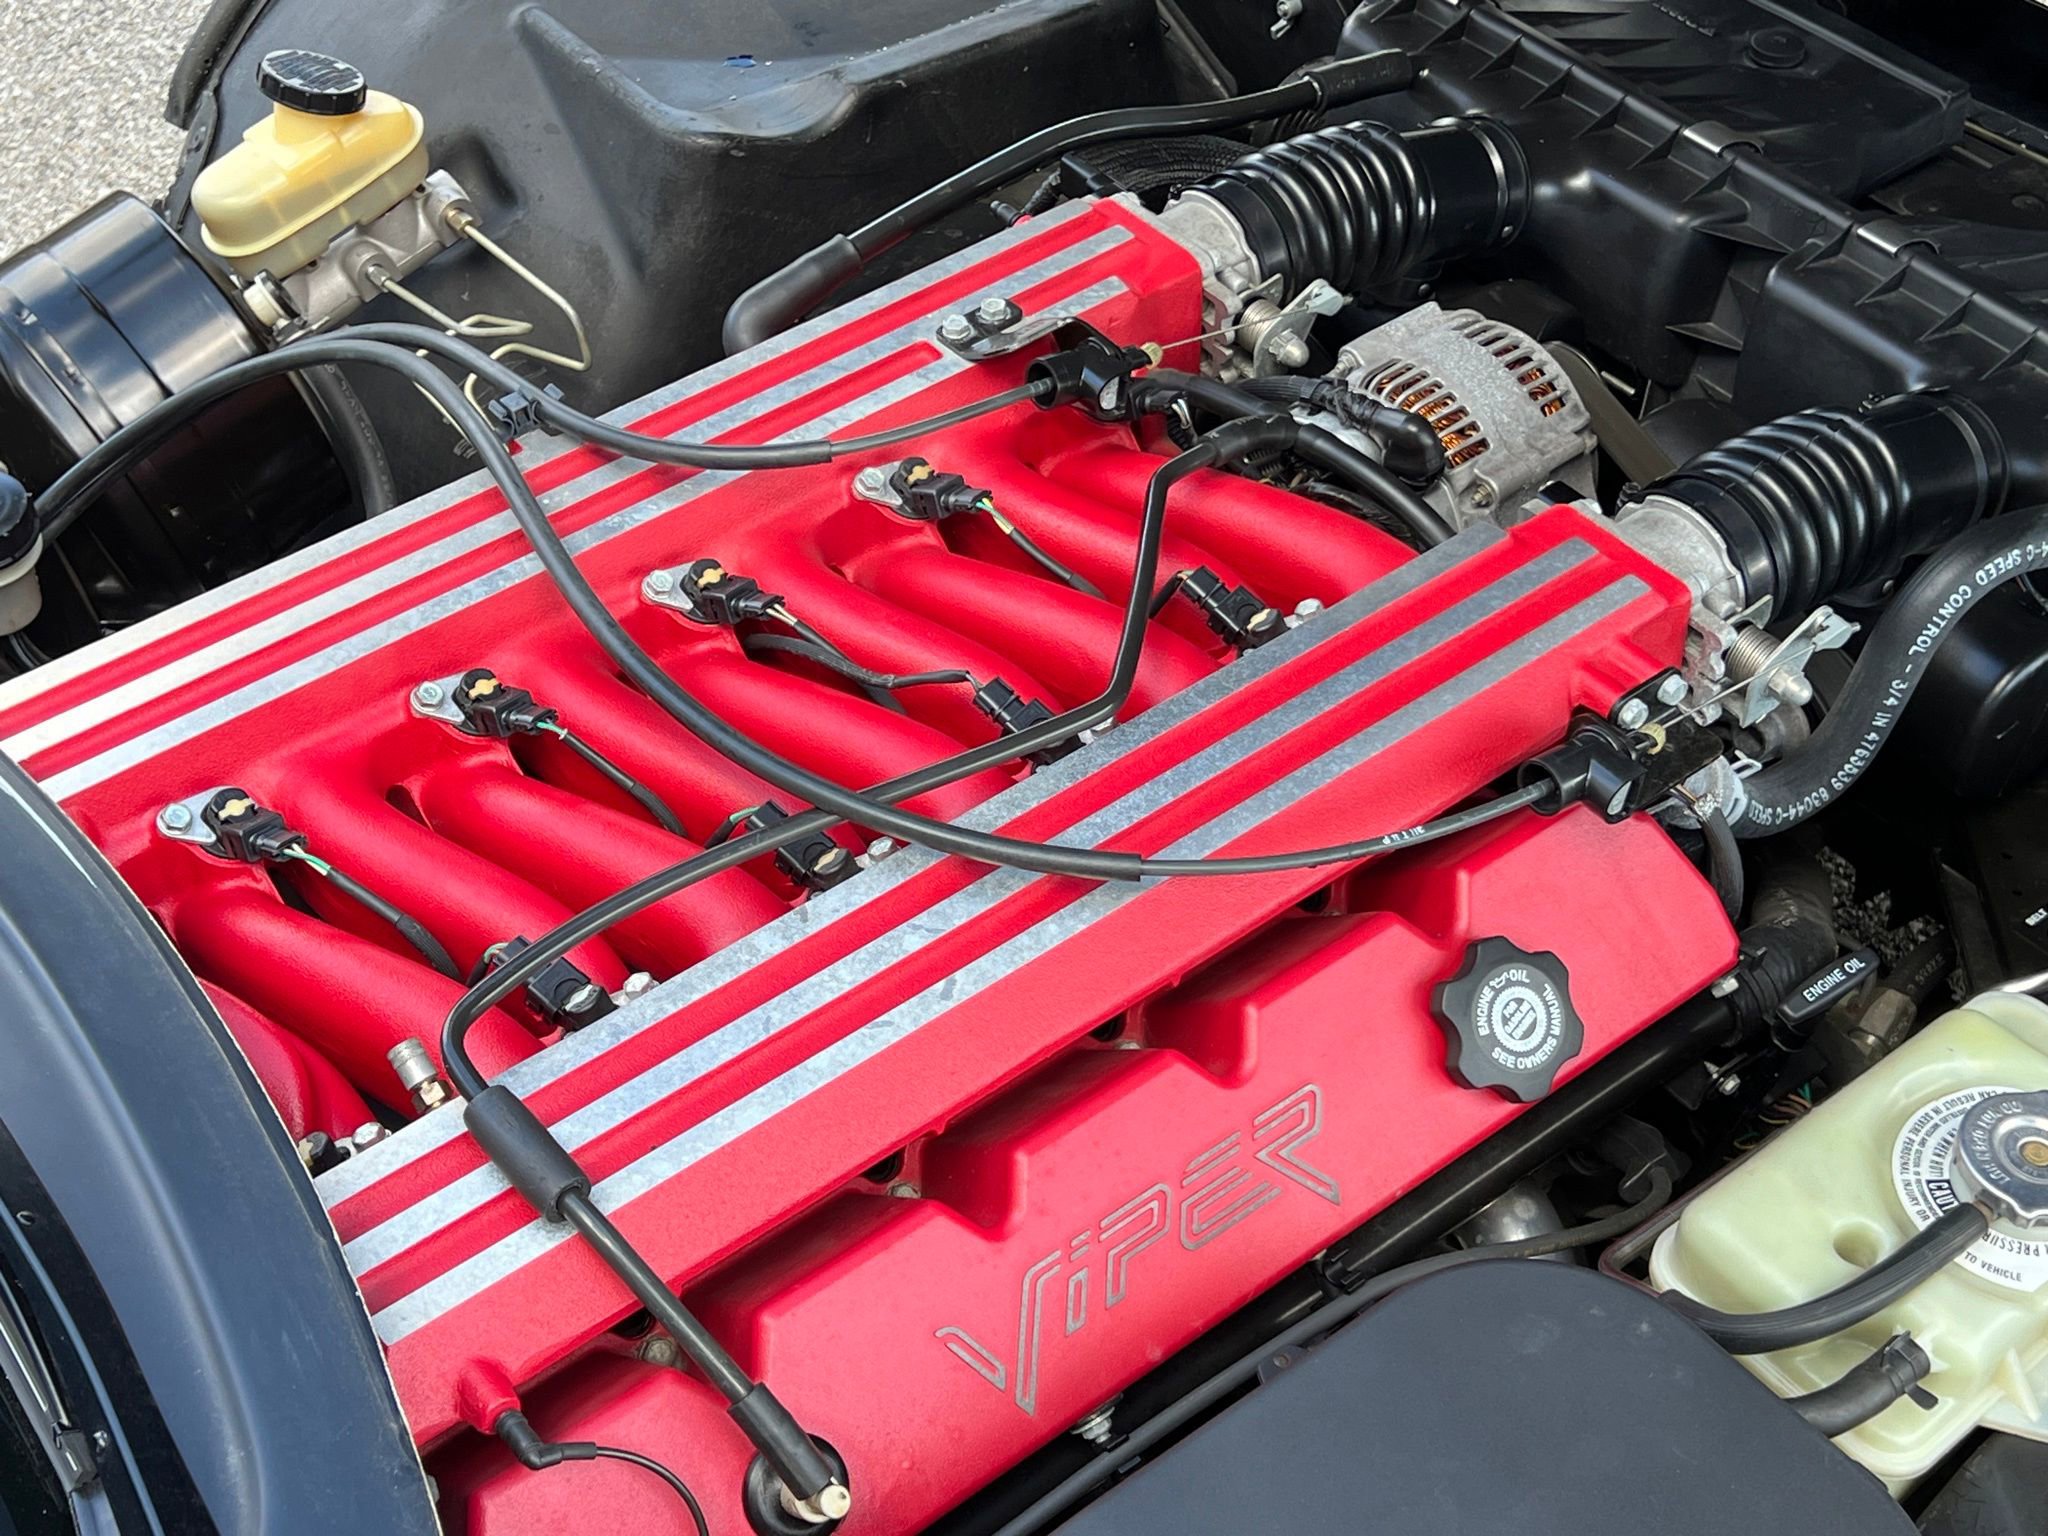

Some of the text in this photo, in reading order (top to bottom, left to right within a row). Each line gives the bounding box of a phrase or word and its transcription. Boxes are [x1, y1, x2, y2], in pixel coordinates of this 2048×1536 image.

[1975, 548, 2021, 587] SPEED
[1908, 584, 1972, 656] CONTROL
[1883, 678, 1909, 708] 3/4
[1872, 712, 1893, 728] IN
[1775, 790, 1830, 826] 83044-C
[1802, 956, 1866, 1002] ENGINE OIL
[1477, 969, 1530, 1036] ENGINE OIL
[1491, 1046, 1515, 1069] SEE
[1543, 983, 1563, 1037] MANUAL
[1933, 1104, 1945, 1117] IN
[1945, 1091, 1977, 1112] RESULT
[1908, 1111, 1935, 1139] SEVERE
[1899, 1137, 1916, 1177] PERSONAL
[1902, 1177, 1922, 1208] INJURY
[1929, 1181, 1958, 1210] CAUT
[1916, 1208, 1932, 1223] OR
[1963, 1250, 1978, 1265] TO
[1981, 1230, 2041, 1257] PRESSUR
[1981, 1260, 2023, 1284] VEHICLE
